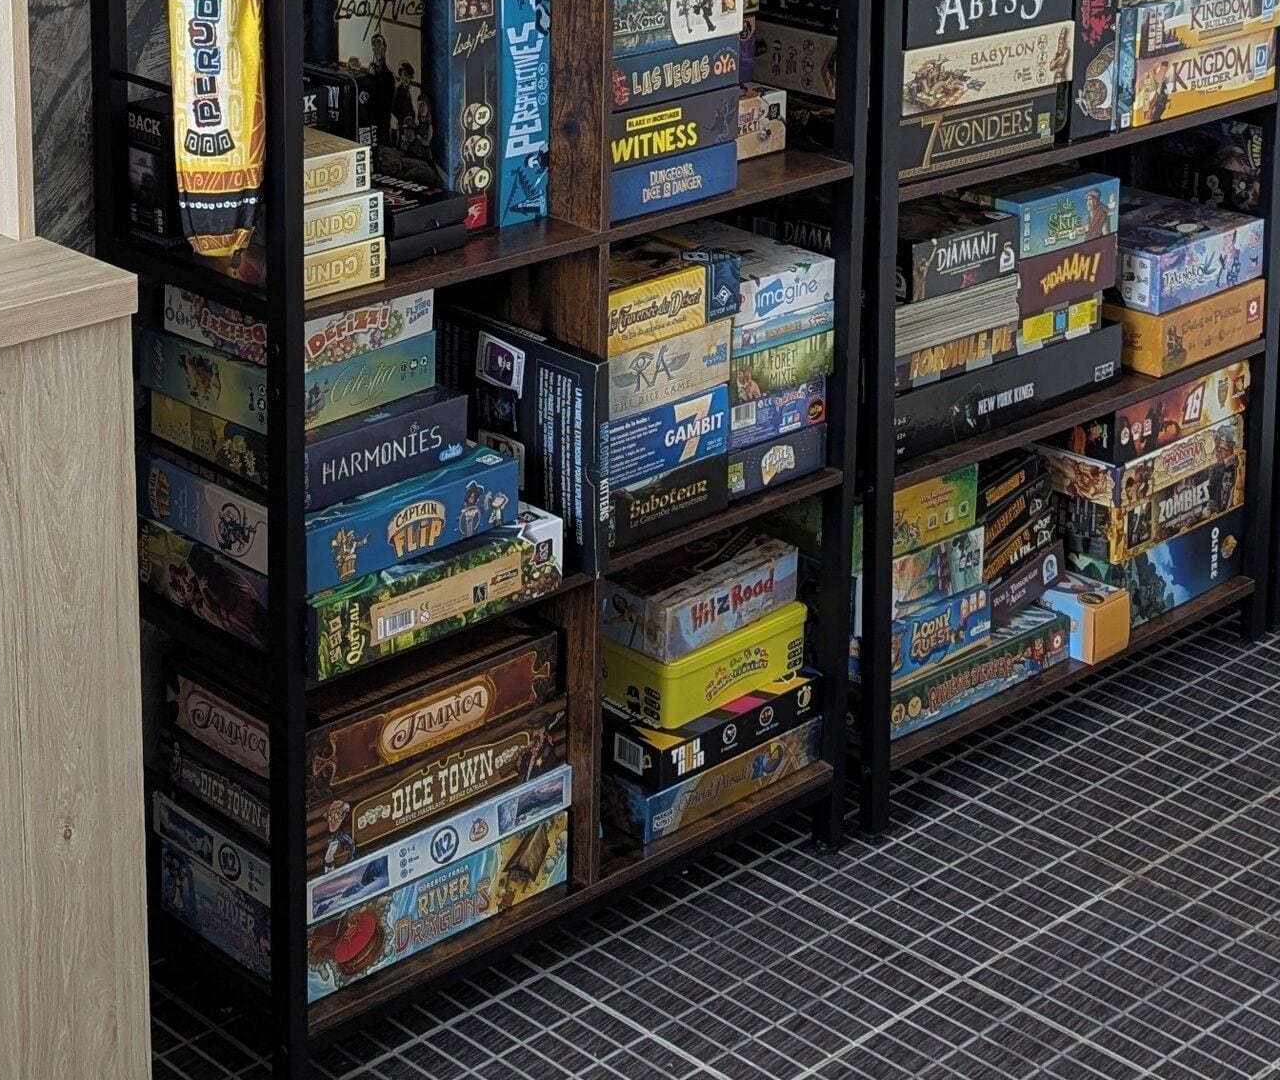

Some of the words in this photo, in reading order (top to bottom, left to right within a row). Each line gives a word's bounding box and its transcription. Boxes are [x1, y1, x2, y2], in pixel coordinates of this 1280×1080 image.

[1204, 13, 1238, 30] BUILDER
[453, 30, 475, 58] Lady
[969, 41, 1036, 68] BABYLON
[632, 74, 661, 97] LAS
[662, 56, 710, 88] VEGAS
[1171, 44, 1252, 94] KINGDOM
[1189, 72, 1233, 91] BUILDER
[504, 21, 545, 159] PERSPECTIVES
[610, 121, 698, 164] WITNESS
[920, 113, 946, 171] 7
[938, 105, 1034, 152] WONDERS
[642, 183, 661, 204] DICE
[671, 174, 703, 197] DANGER
[936, 231, 999, 273] DIAMANT
[755, 276, 818, 310] imagine
[1039, 250, 1102, 297] TADAAAM!
[305, 305, 391, 361] DÉFIZZ!
[770, 347, 797, 370] FORÊT
[908, 330, 988, 381] FORMULE
[769, 368, 797, 387] MIXTE
[613, 397, 634, 413] THE
[638, 389, 659, 405] DICE
[978, 397, 996, 416] NEW
[996, 391, 1013, 410] YORK
[1013, 382, 1035, 404] KINGS
[664, 412, 725, 448] GAMBIT
[673, 392, 714, 463] 7
[322, 423, 443, 486] HARMONIES
[600, 421, 610, 478] IMPLODING
[394, 504, 438, 528] CAPTAIN
[599, 478, 610, 522] KITTENS
[629, 478, 708, 519] Saboteur
[1158, 481, 1211, 522] ZOMBIES
[391, 516, 443, 560] FLIP
[1009, 550, 1019, 565] LA
[690, 598, 715, 633] Hit
[730, 568, 776, 607] Road
[346, 602, 361, 665] QUETZAL
[911, 607, 952, 641] LOONY
[911, 630, 953, 657] QUEST
[389, 686, 487, 752] JAMAICA
[391, 775, 434, 821] DICE
[438, 749, 495, 798] TOWN
[434, 831, 455, 859] K2
[417, 874, 470, 917] RIVER
[394, 880, 491, 954] DRAGONS
